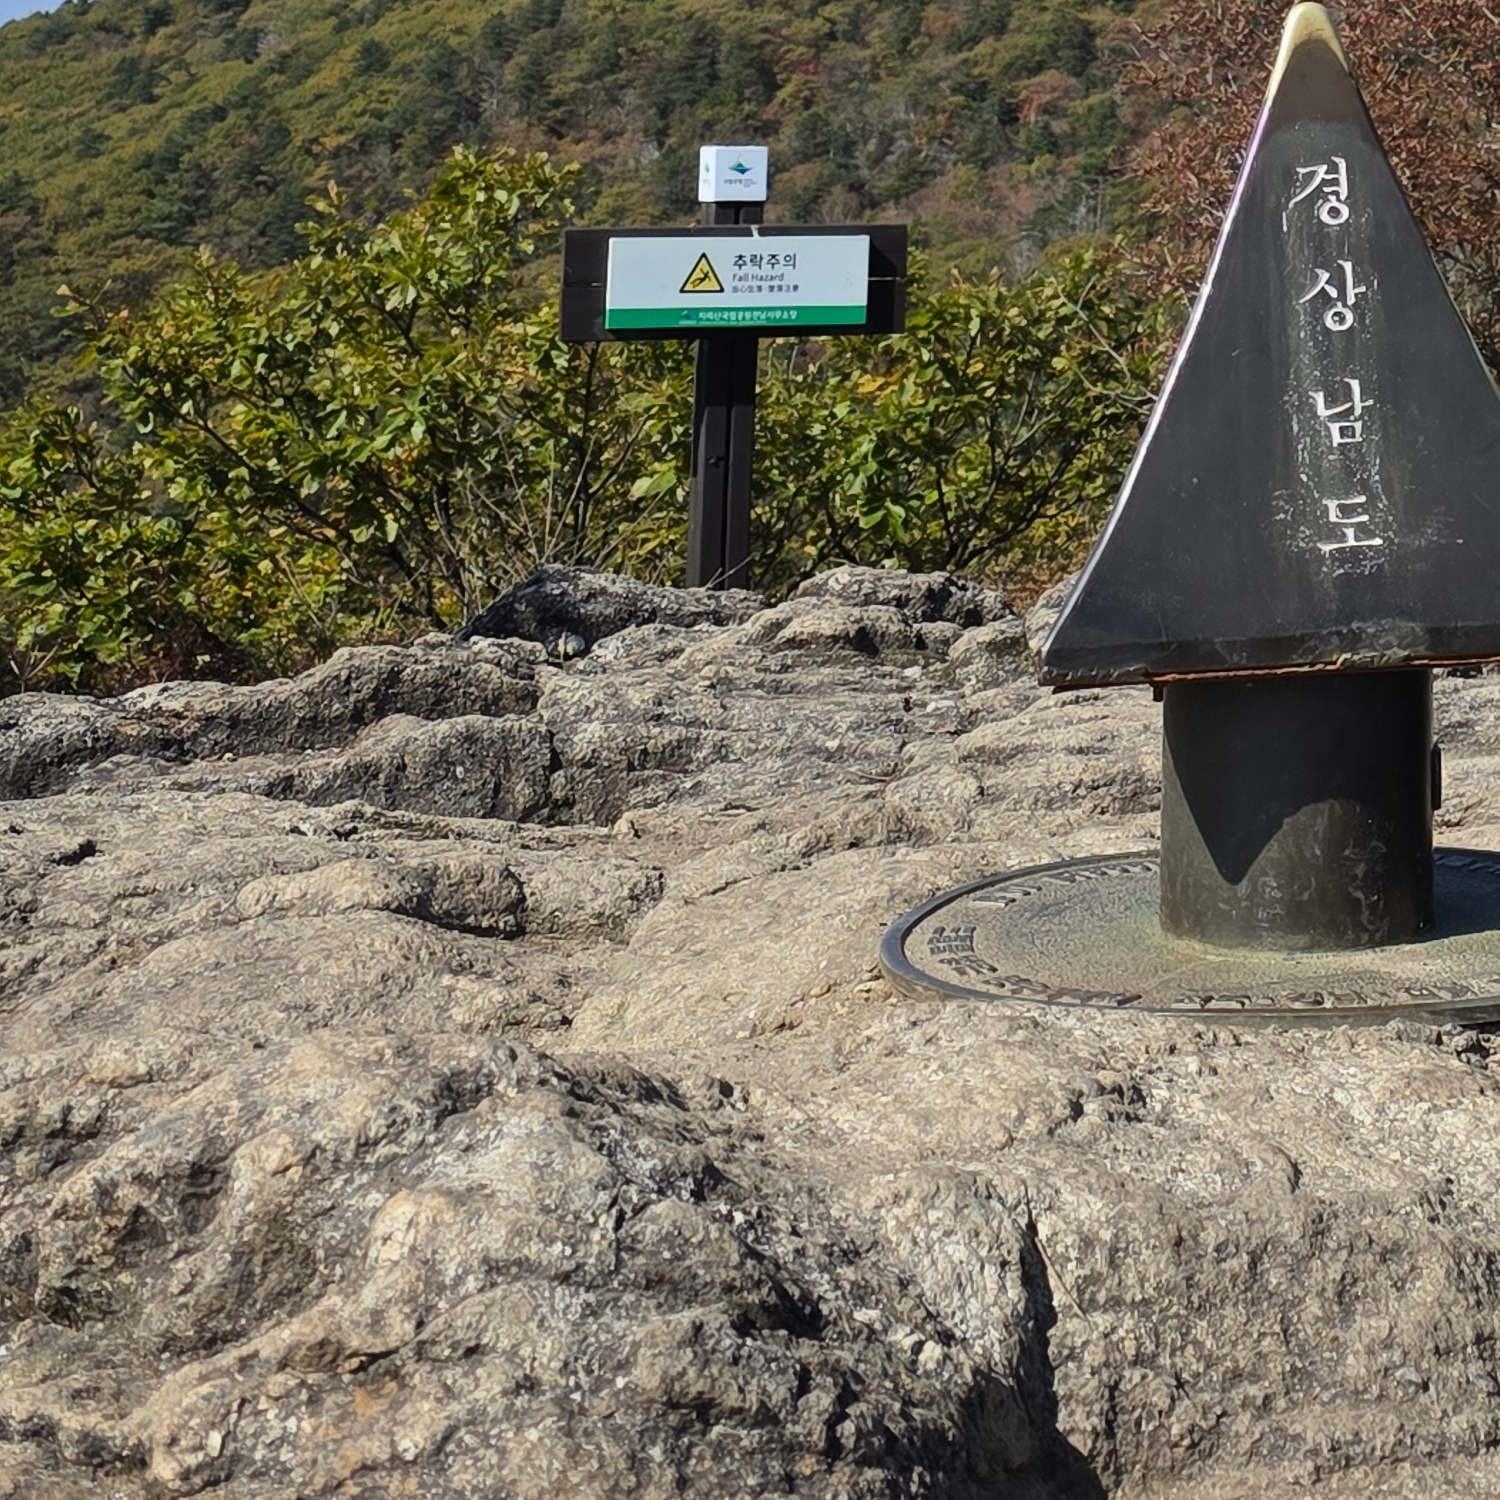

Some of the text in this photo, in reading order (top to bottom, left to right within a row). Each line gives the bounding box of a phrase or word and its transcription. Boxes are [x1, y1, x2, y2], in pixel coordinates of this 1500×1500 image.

[733, 253, 796, 270] 추락주의
[732, 272, 785, 283] Fall Hazard
[1288, 156, 1384, 550] 경상남도
